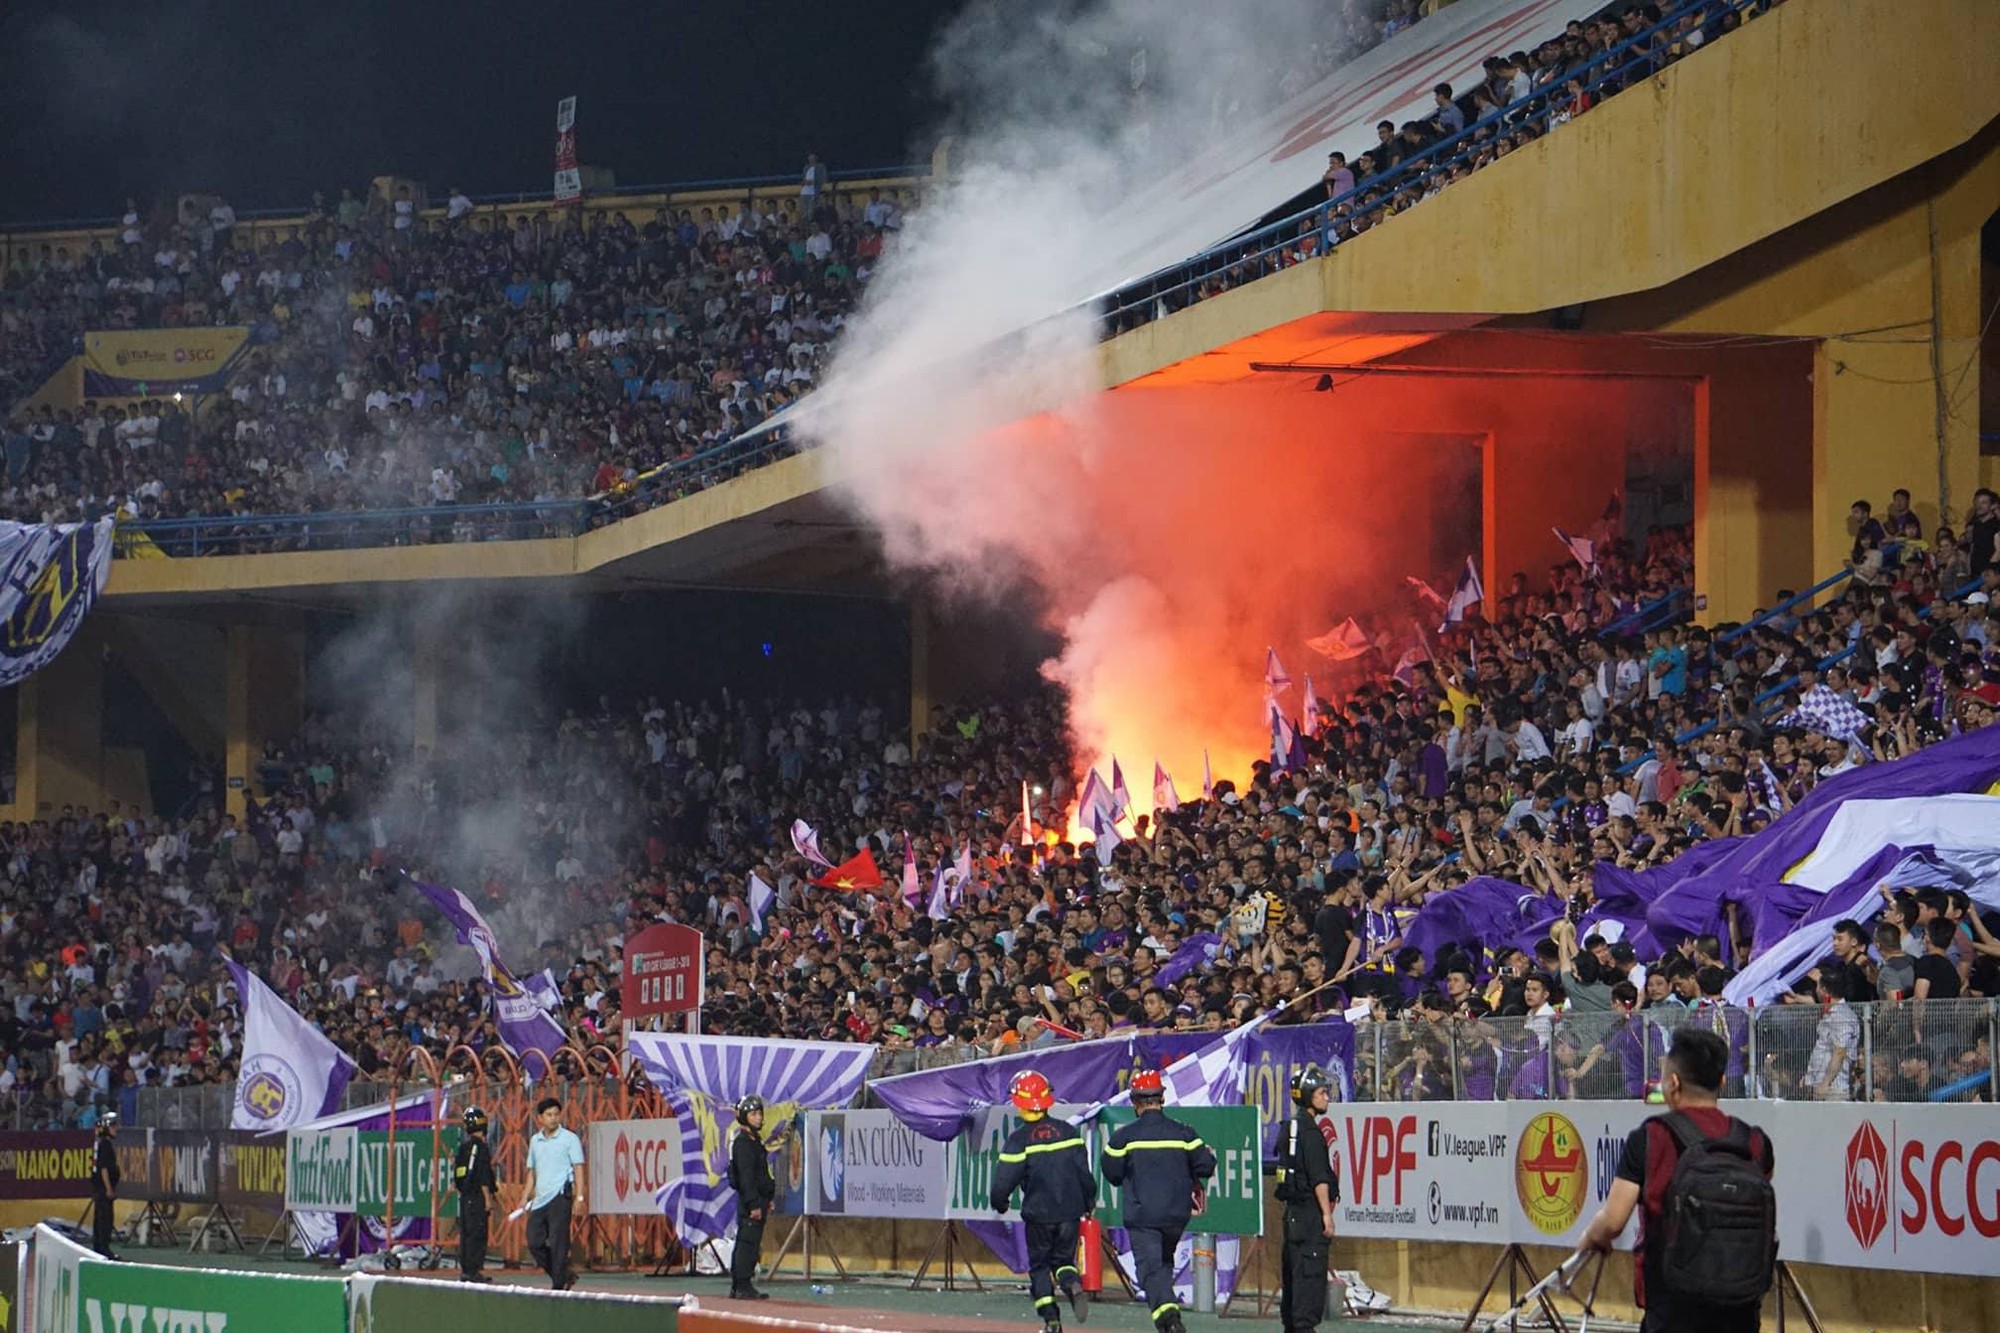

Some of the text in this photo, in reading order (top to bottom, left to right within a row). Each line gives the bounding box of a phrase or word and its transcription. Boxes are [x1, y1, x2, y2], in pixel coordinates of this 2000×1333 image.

[16, 1148, 60, 1180] NANO
[61, 1148, 94, 1180] ONE
[633, 1139, 667, 1193] SCG
[847, 1127, 868, 1166] AN
[1206, 1135, 1254, 1199] AFÉ
[1345, 1115, 1418, 1206] VPF
[1444, 1134, 1507, 1163] V.league.VPF
[289, 1135, 353, 1205] NutiFood
[1900, 1139, 2000, 1239] SCG
[1344, 1207, 1417, 1224] Vietnam Professional Football
[1443, 1201, 1499, 1229] www.vpf.vn
